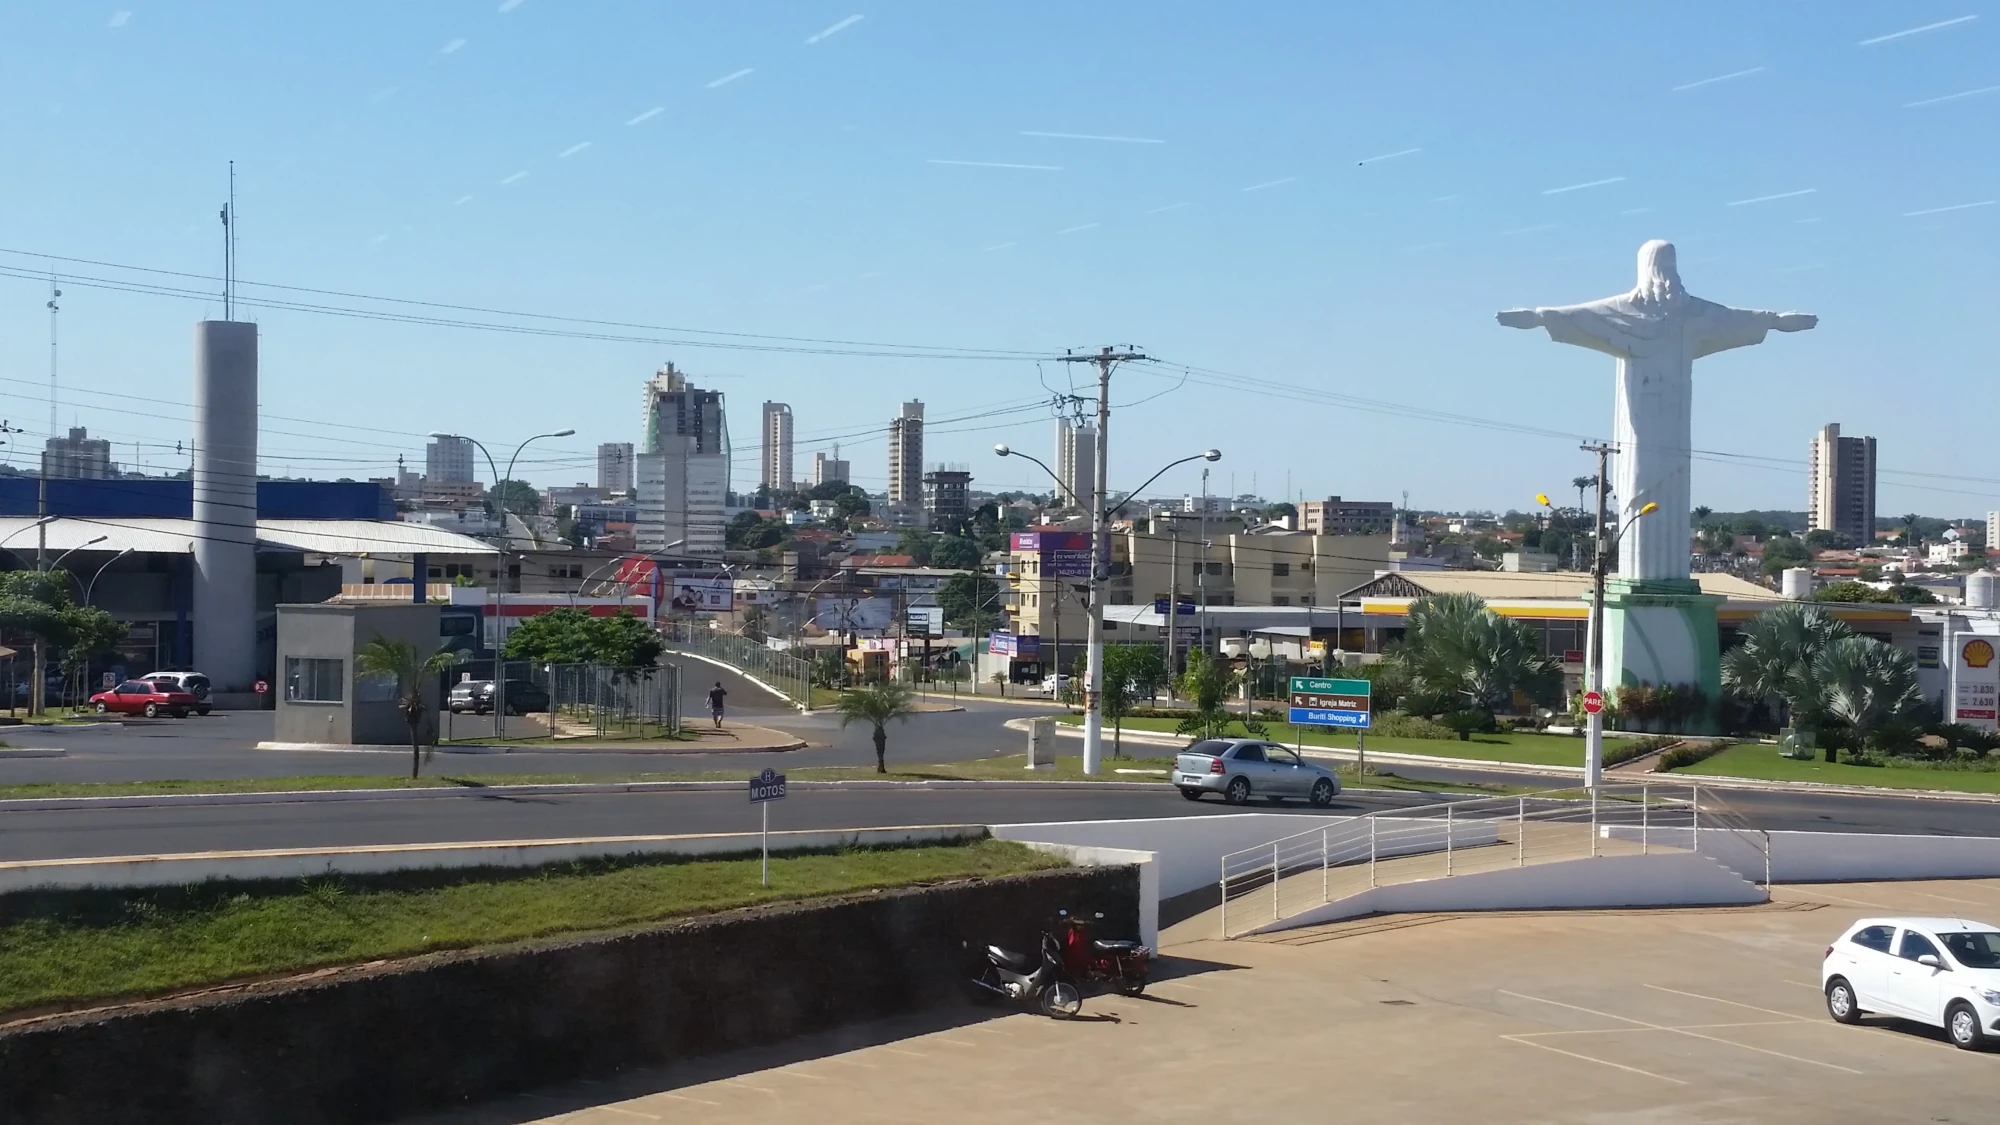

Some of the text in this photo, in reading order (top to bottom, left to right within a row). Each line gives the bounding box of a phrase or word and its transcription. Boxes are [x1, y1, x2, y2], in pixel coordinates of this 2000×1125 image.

[1310, 681, 1332, 689] Centro
[1320, 699, 1337, 707] Igreja
[1308, 712, 1356, 723] Buriti Shopping
[752, 784, 784, 798] MOTOS
